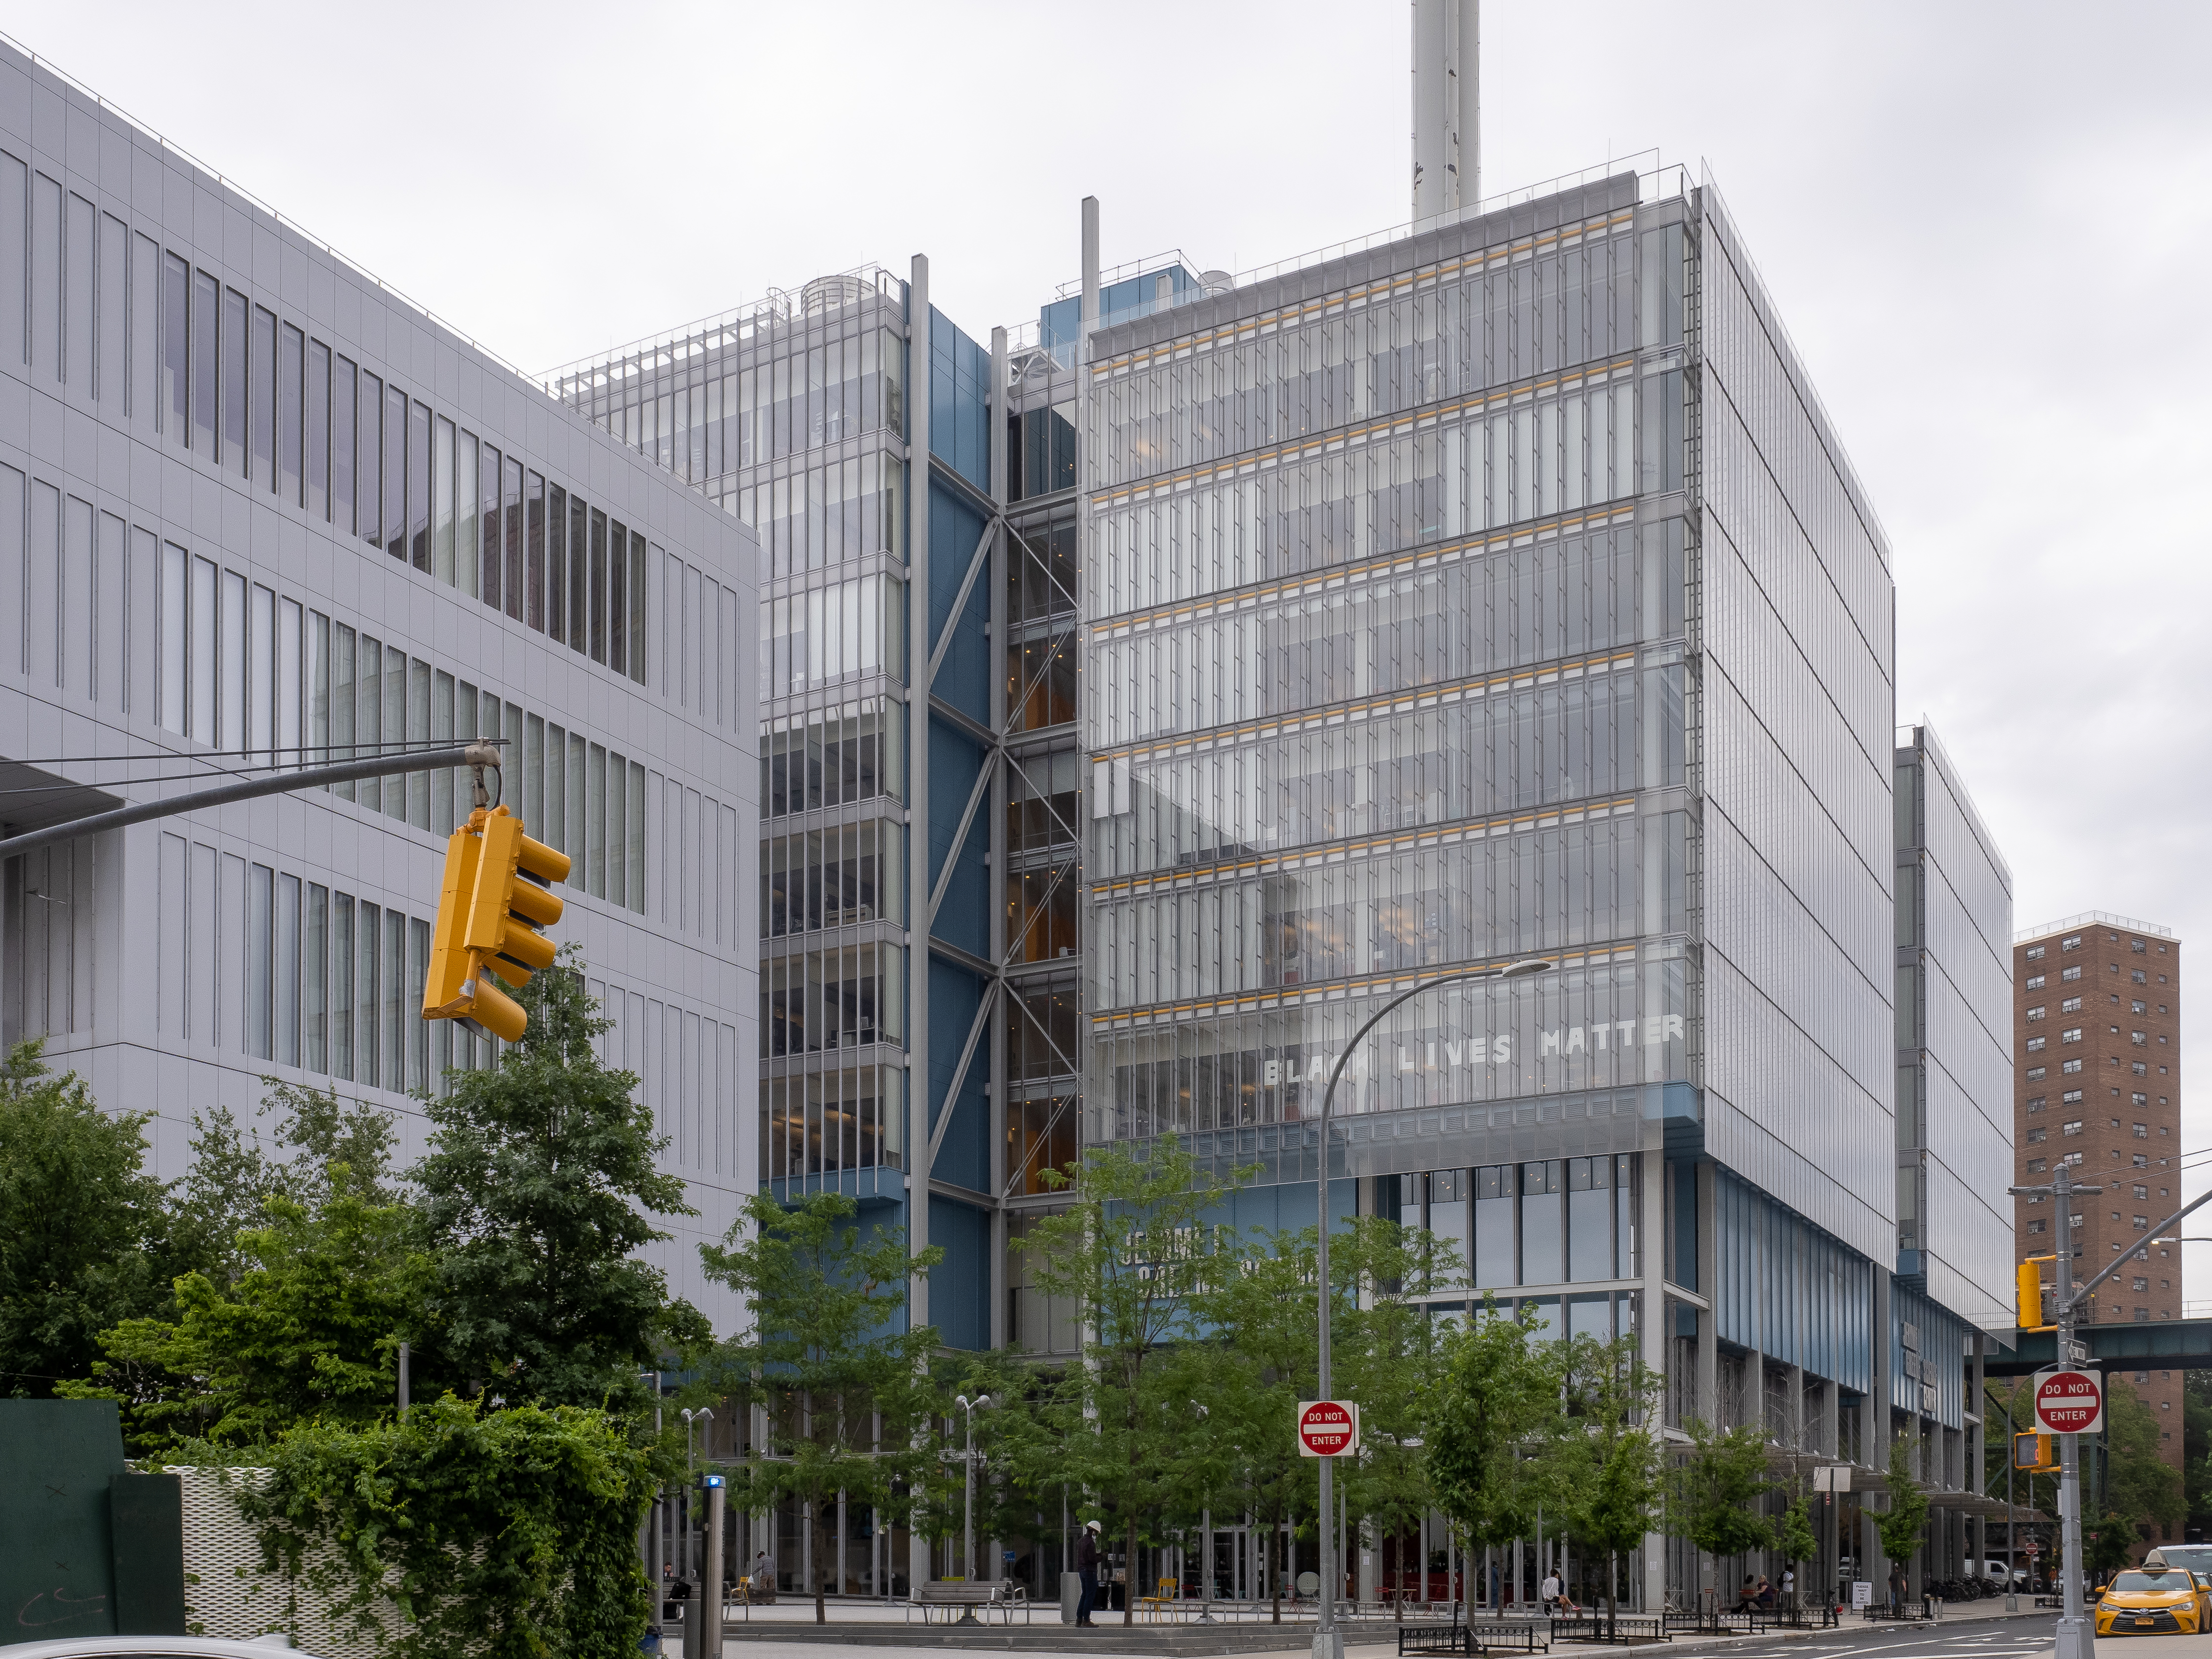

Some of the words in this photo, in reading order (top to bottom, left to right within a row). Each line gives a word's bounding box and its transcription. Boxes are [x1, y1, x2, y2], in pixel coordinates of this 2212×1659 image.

[1398, 1034, 1514, 1070] LIVES
[1540, 1014, 1684, 1057] MATTER
[2046, 1384, 2061, 1394] DO
[2068, 1383, 2091, 1393] NOT
[1309, 1413, 1322, 1422] DO
[1325, 1412, 1343, 1421] NOT
[2050, 1411, 2087, 1421] ENTER
[1312, 1436, 1342, 1445] ENTER
